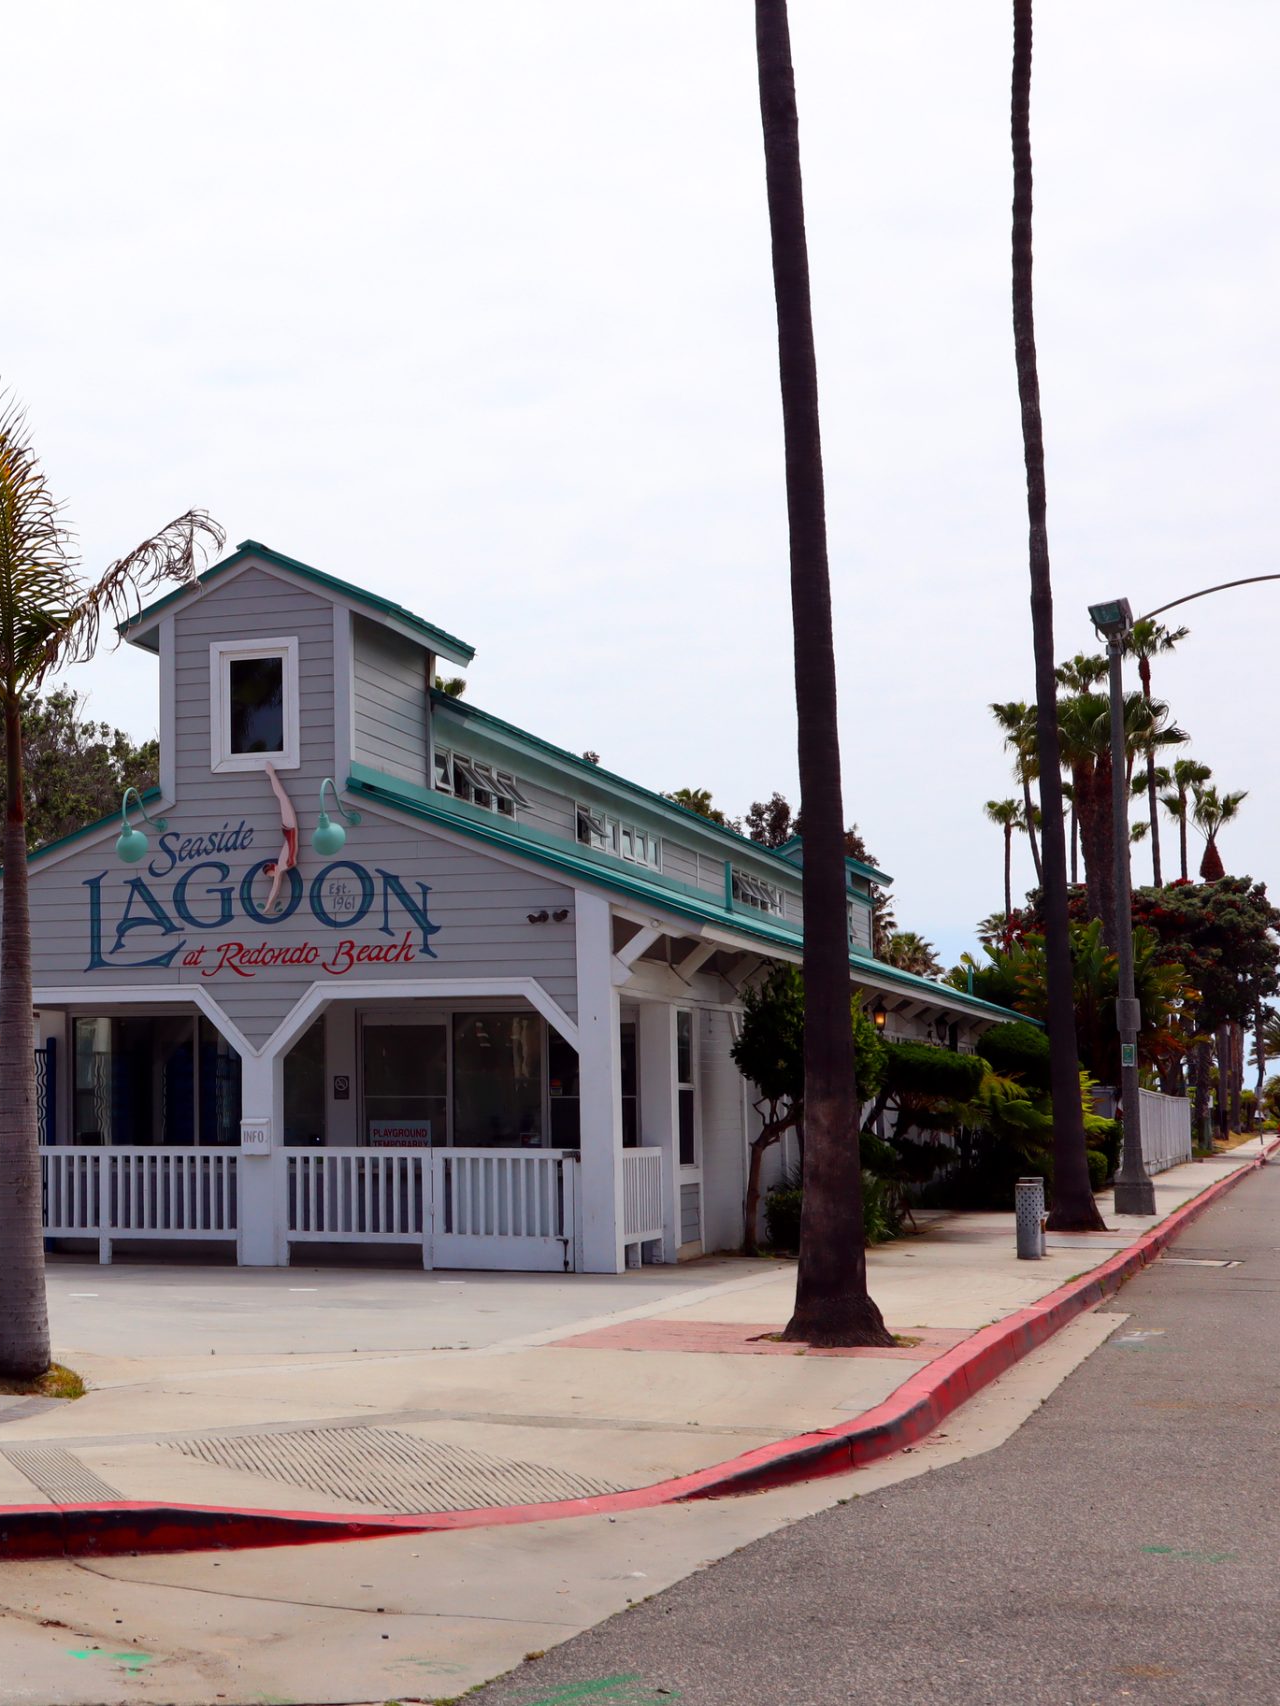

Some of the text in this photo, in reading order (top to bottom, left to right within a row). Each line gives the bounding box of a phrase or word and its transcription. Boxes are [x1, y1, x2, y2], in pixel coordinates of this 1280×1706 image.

[148, 820, 254, 877] Seaside
[328, 882, 352, 895] Est.
[332, 895, 355, 911] 1961
[82, 858, 442, 972] LAGOON
[182, 931, 416, 978] at Redondo Beach
[372, 1128, 428, 1138] PLAYGROUND
